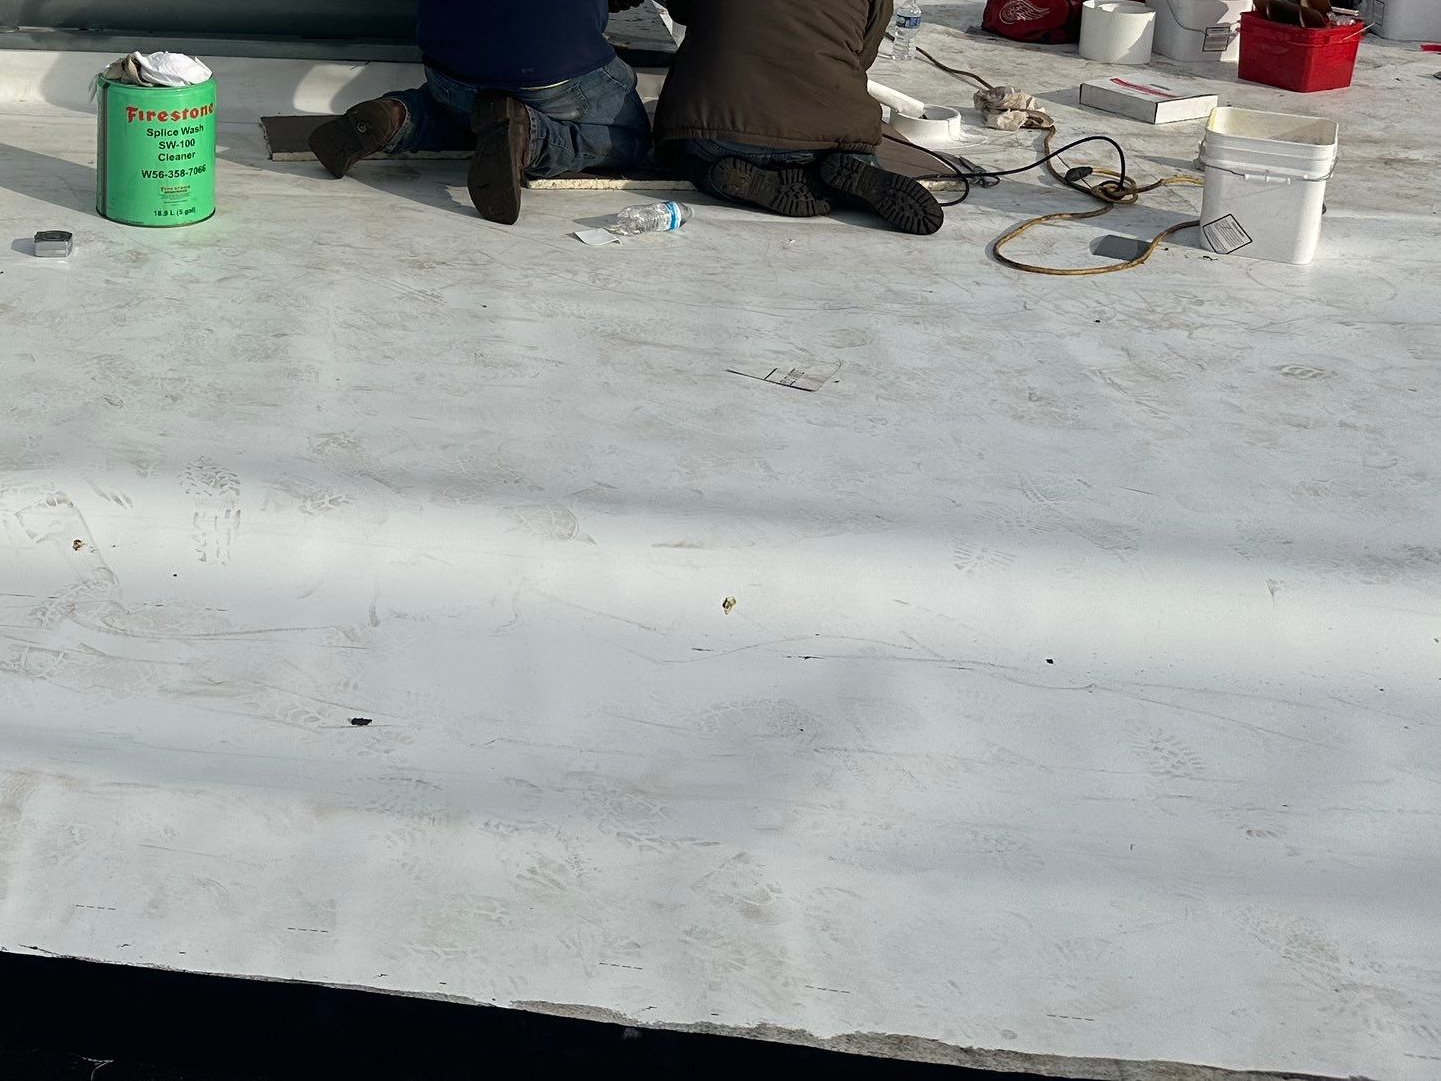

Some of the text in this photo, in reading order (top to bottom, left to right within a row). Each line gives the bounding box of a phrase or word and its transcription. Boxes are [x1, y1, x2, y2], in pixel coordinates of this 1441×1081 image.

[126, 102, 214, 123] Firestone
[146, 124, 204, 138] Splice Wash
[159, 139, 195, 150] SW-100
[158, 152, 196, 162] Cleaner
